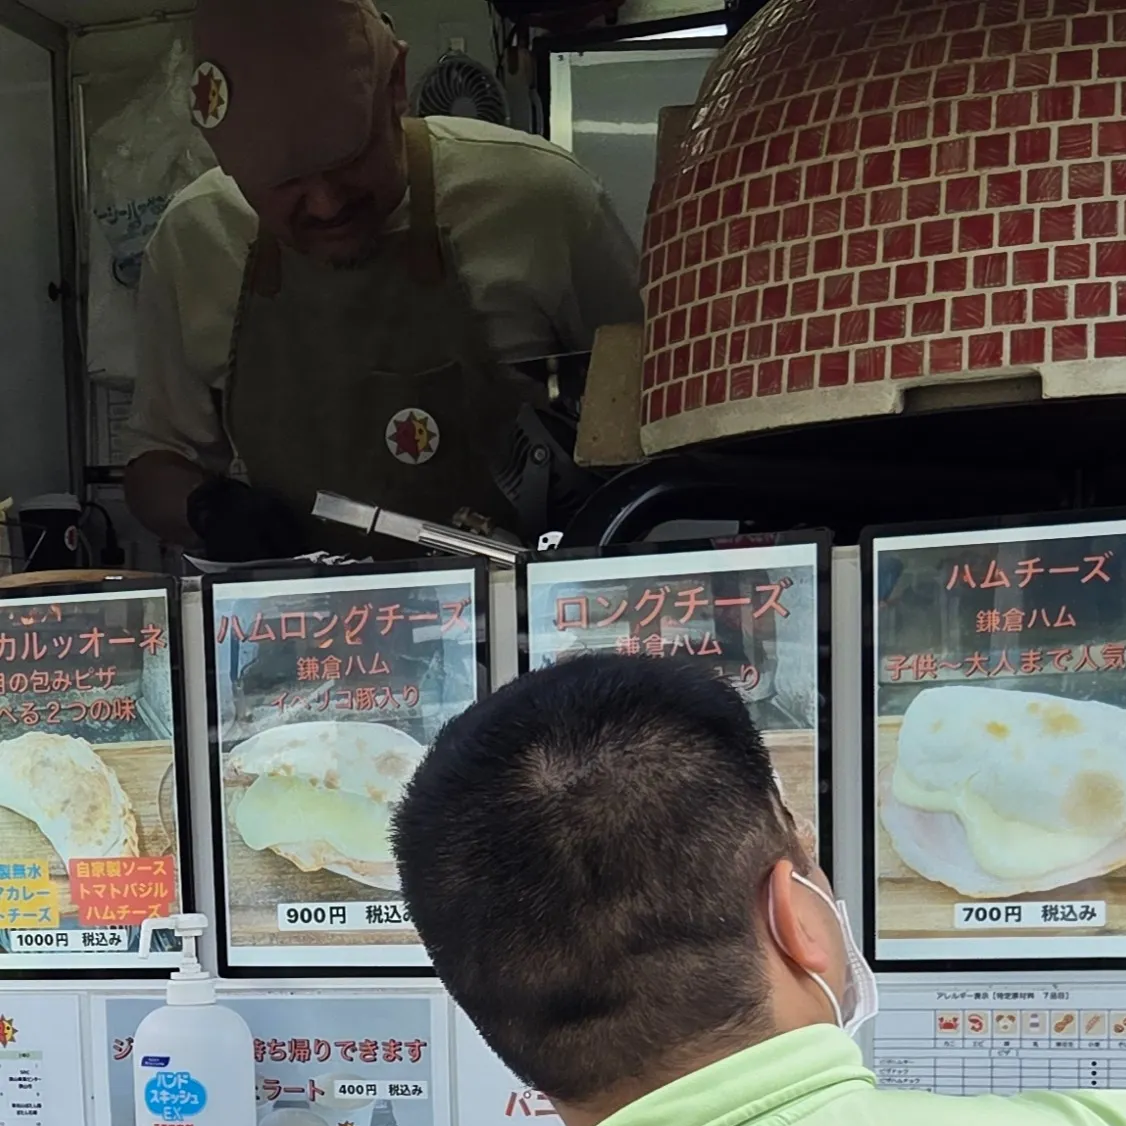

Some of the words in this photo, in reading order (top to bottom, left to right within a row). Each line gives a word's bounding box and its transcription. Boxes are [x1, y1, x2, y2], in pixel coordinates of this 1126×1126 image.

[945, 551, 1113, 591] ハムチーズ
[556, 576, 793, 630] ロングチーズ
[217, 599, 471, 645] ハムロングチーズ
[975, 605, 1076, 633] 鎌倉ハム
[297, 653, 391, 681] 鎌倉ハム
[0, 665, 116, 695] の包みピザ
[76, 860, 167, 878] 自家製ソース
[0, 885, 50, 901] カレー
[79, 882, 169, 901] トマトバジル
[0, 907, 52, 923] チーズ
[86, 903, 163, 922] ハムチーズ
[286, 905, 347, 925] 900円
[961, 906, 1022, 924] 700円
[1041, 904, 1098, 923] 税込み
[17, 932, 69, 947] 1000円
[82, 932, 122, 947] 税込み
[156, 1073, 189, 1090] ハンド
[256, 1079, 325, 1102] ラート
[339, 1084, 377, 1096] 400円
[388, 1084, 423, 1096] 税込み
[163, 1106, 183, 1121] EX
